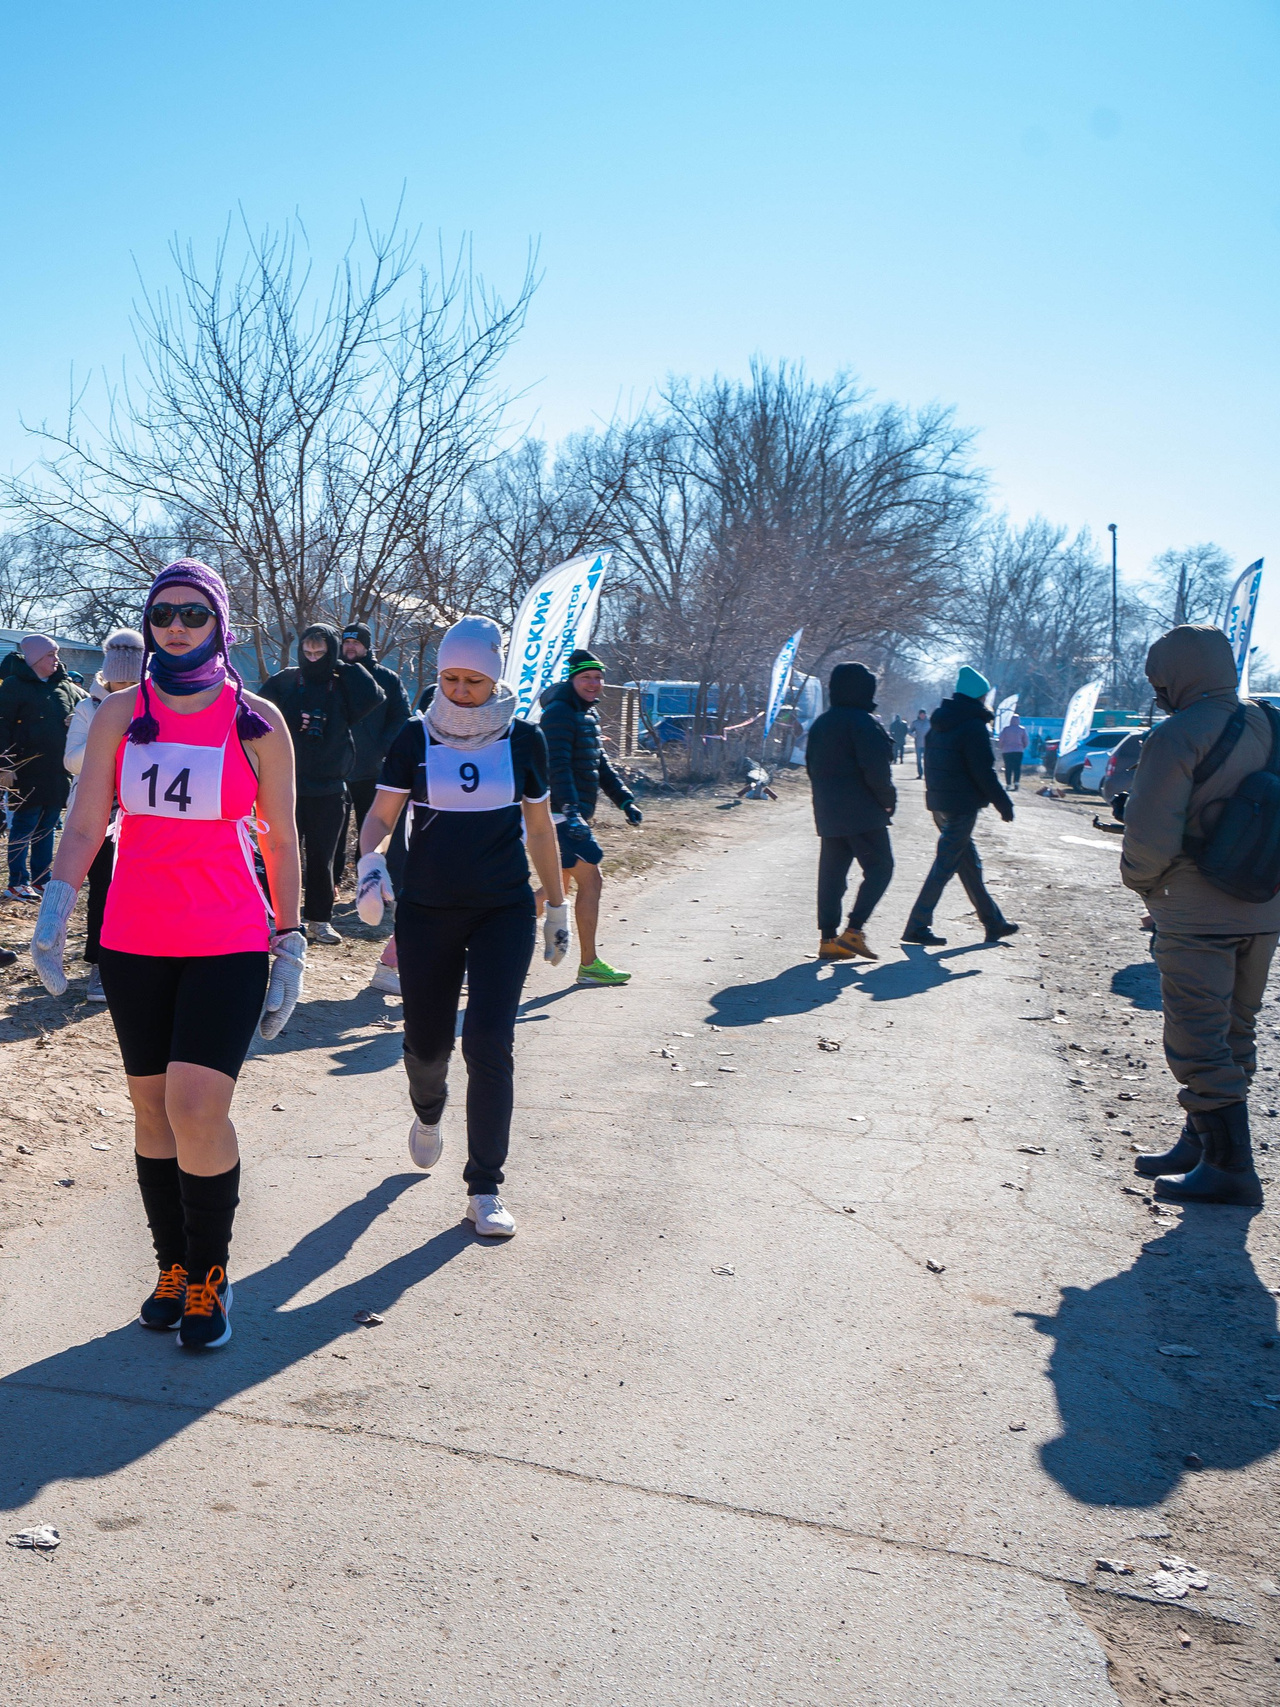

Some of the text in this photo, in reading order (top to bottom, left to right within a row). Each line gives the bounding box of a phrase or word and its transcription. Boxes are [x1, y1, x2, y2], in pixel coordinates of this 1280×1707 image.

[515, 591, 554, 719] ОЛЖСКИЙ
[141, 763, 191, 812] 14
[459, 762, 480, 793] 9
